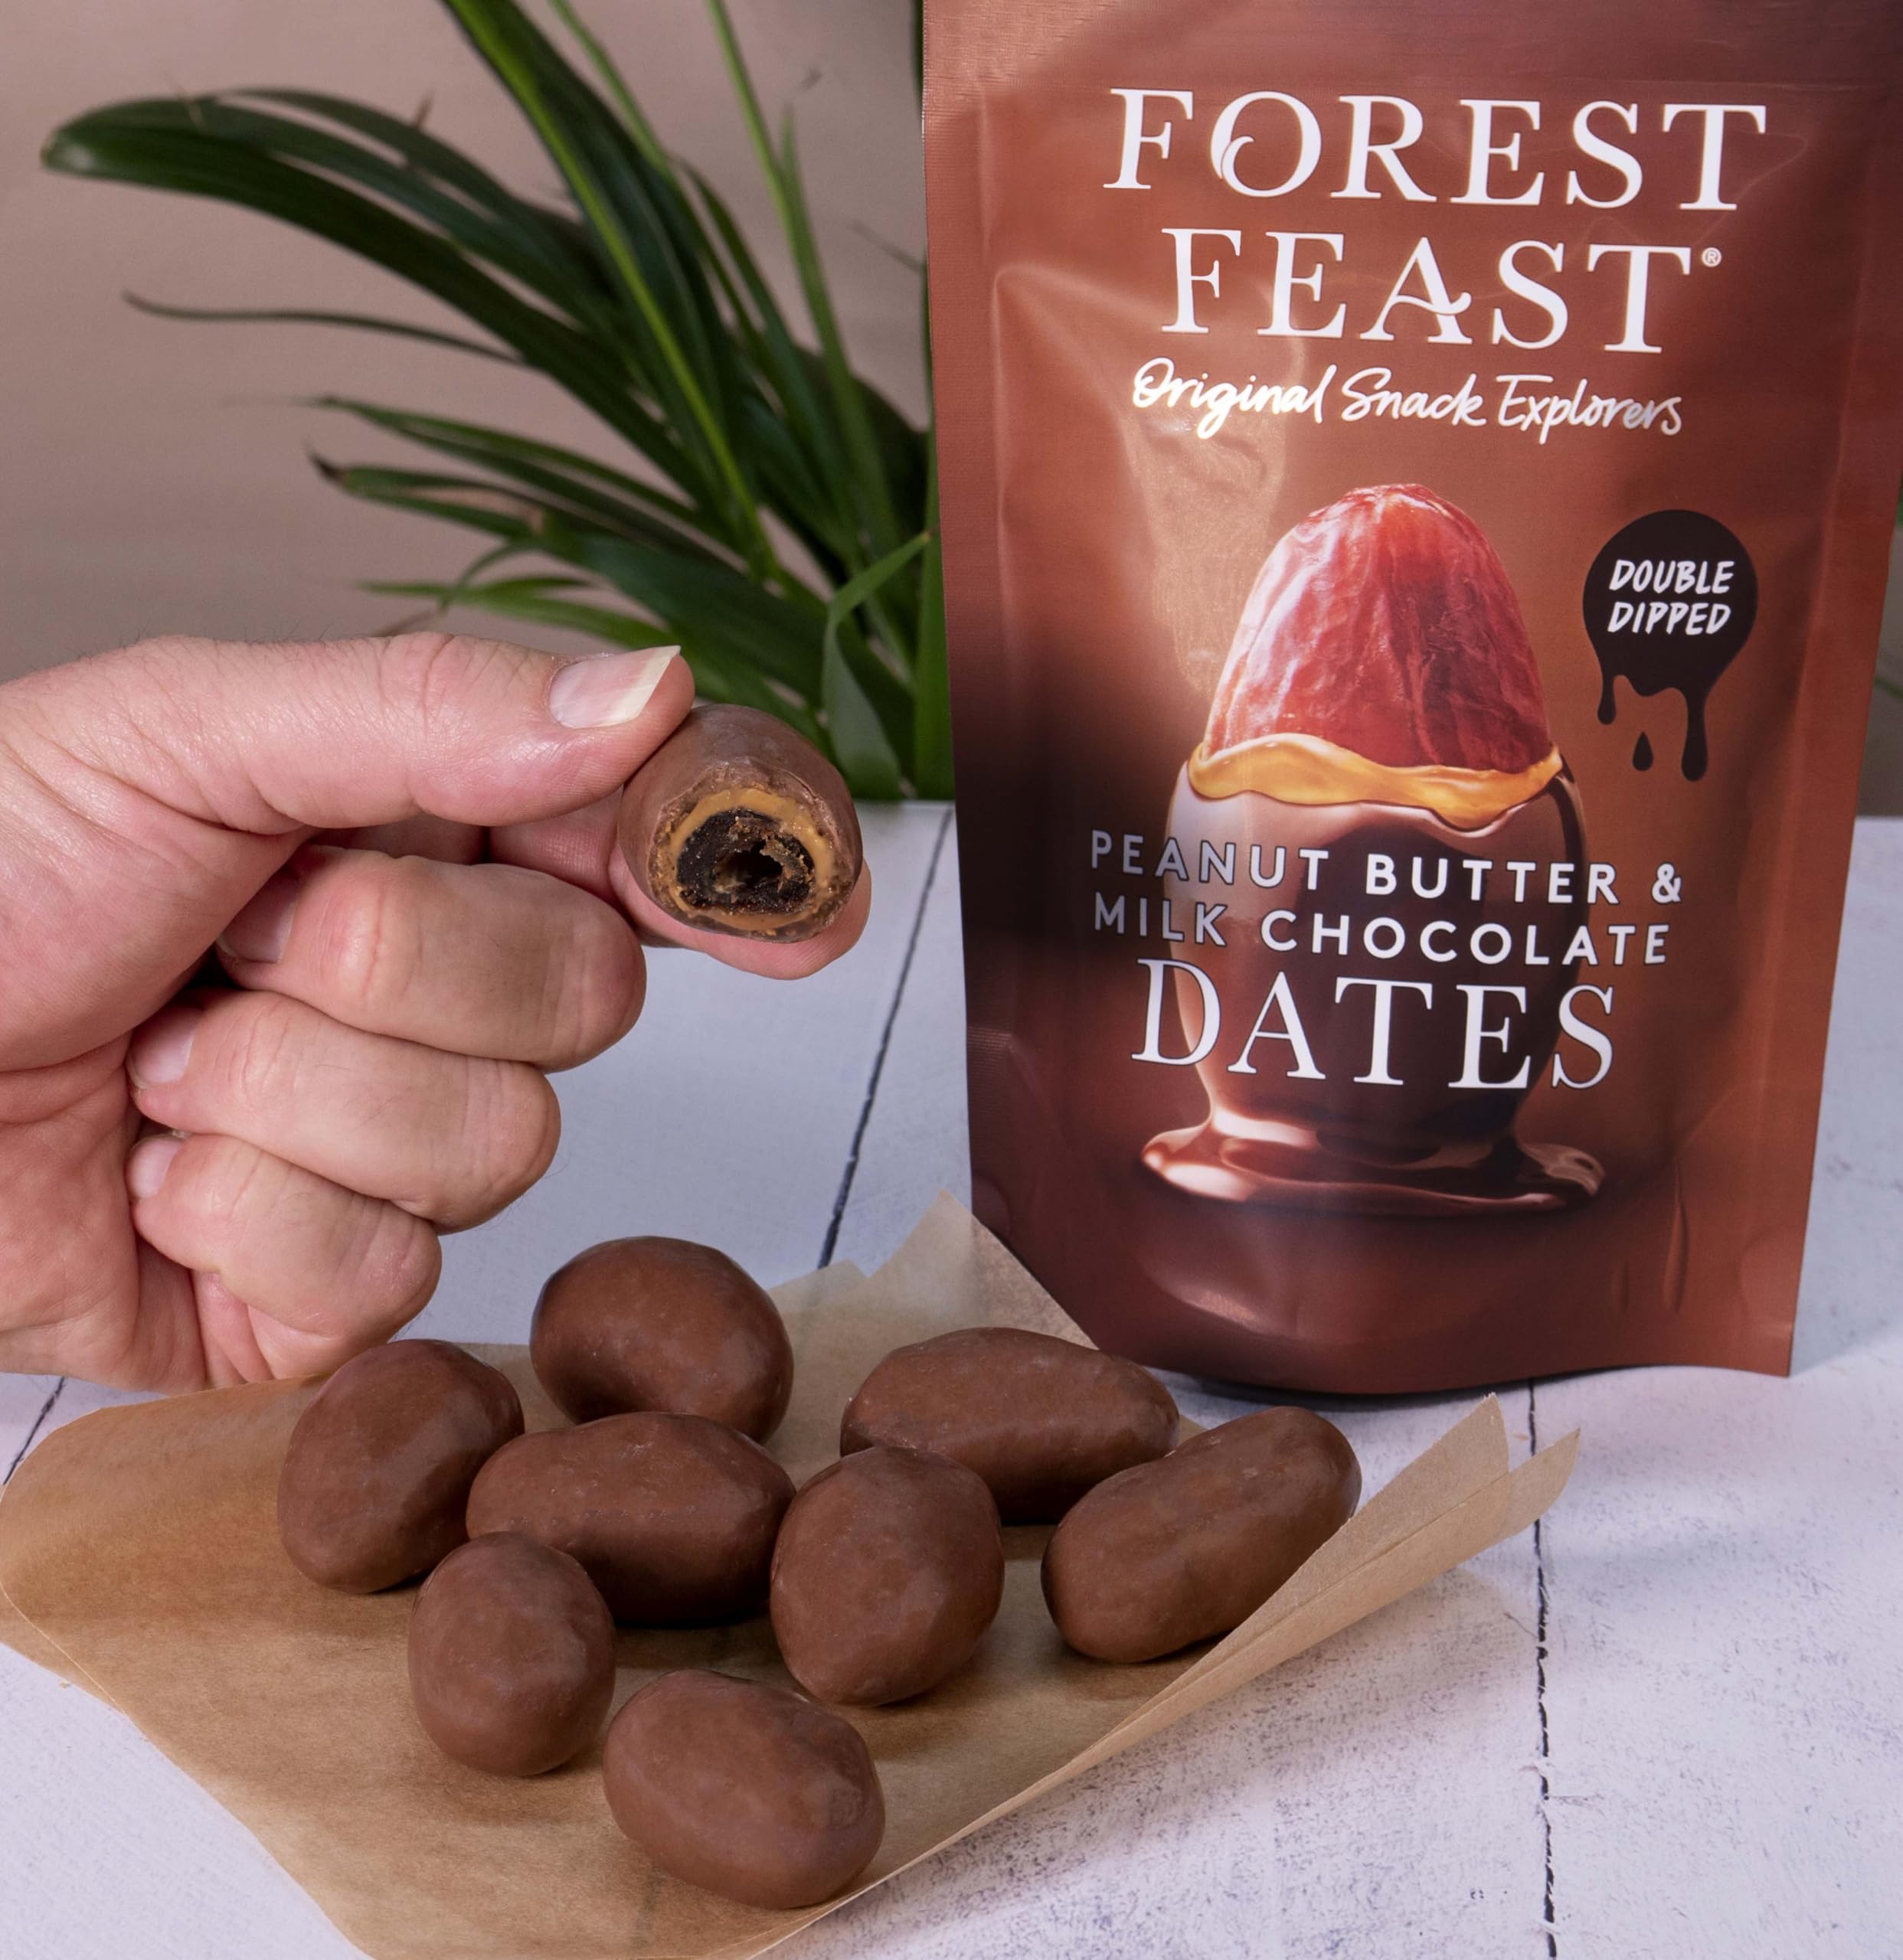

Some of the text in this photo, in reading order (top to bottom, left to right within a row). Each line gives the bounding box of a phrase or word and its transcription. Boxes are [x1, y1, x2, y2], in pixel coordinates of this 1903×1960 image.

[1103, 87, 1767, 211] FOREST
[1132, 358, 1683, 445] Original Snack Explorers
[1609, 559, 1735, 594] DOUBLE
[1607, 601, 1731, 635] DIPPED
[1091, 829, 1682, 905] PEANUT BUTTER &
[1094, 891, 1670, 965] MILK CHOCOLATE
[1131, 957, 1614, 1089] DATES
